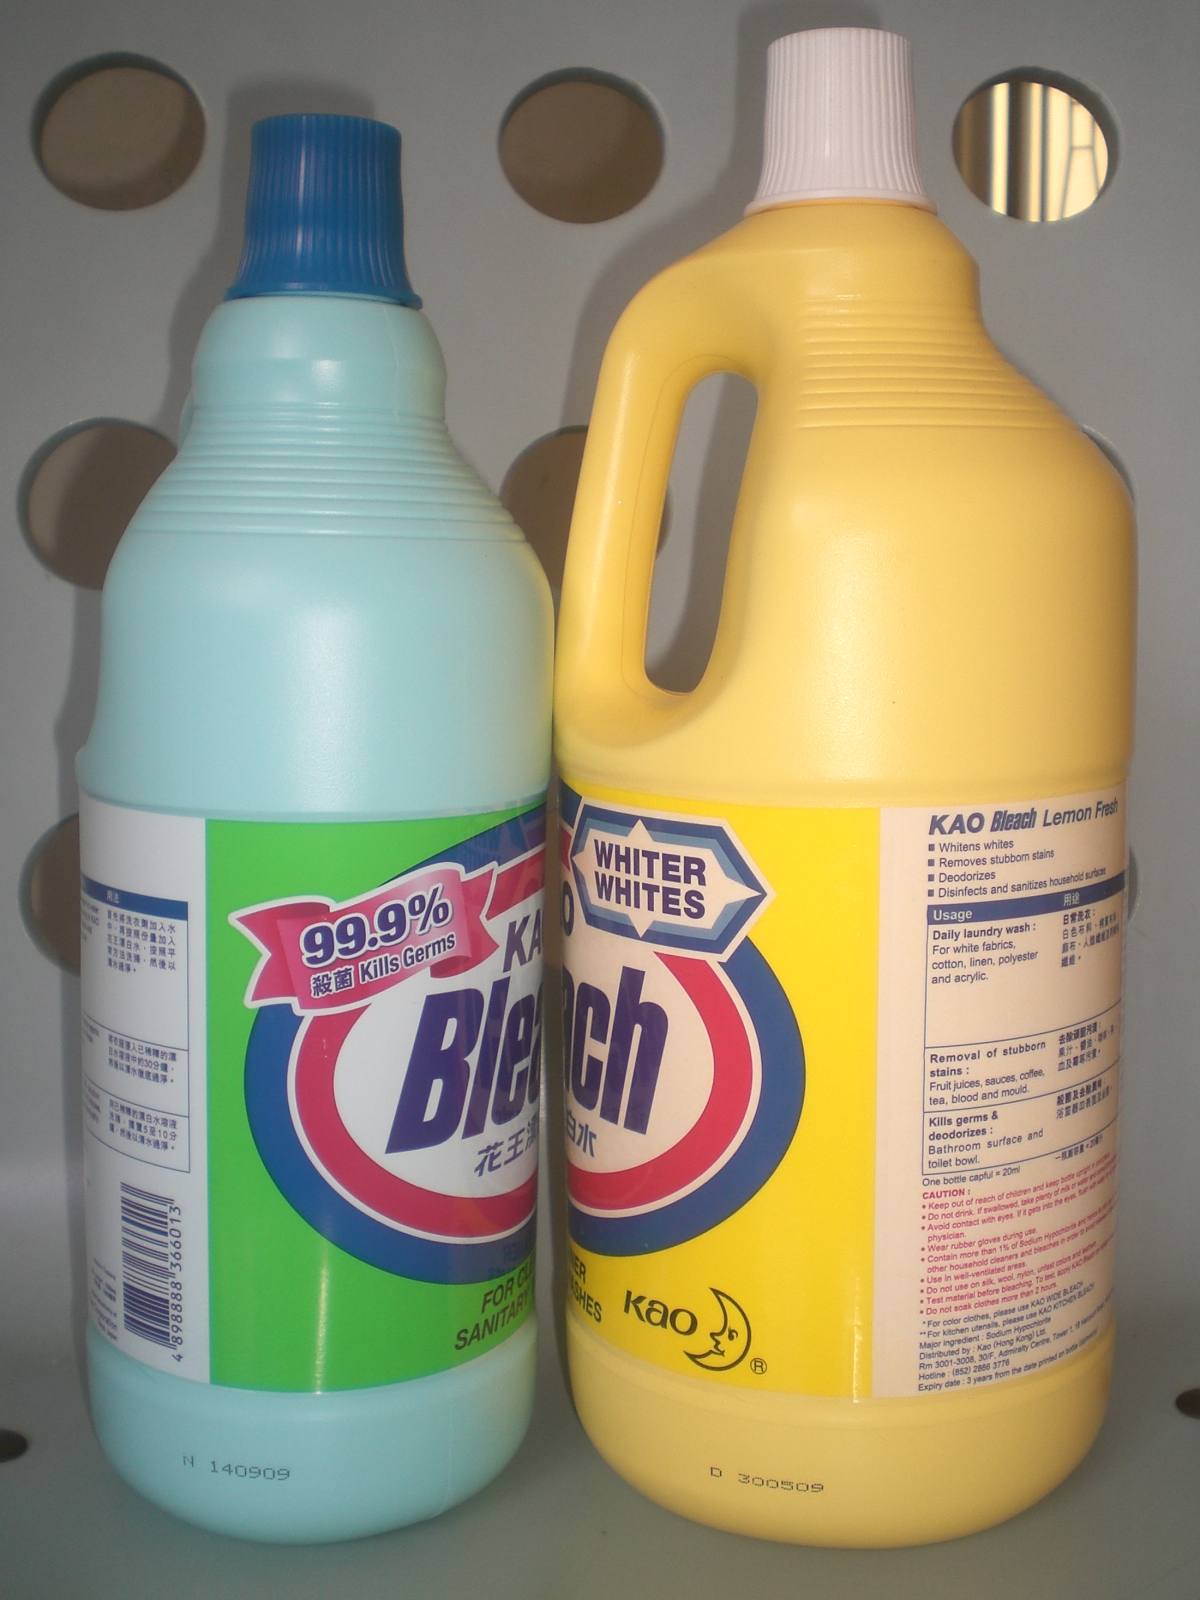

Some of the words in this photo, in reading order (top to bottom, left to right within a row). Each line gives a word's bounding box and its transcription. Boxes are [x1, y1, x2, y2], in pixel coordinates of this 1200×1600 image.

[929, 813, 985, 835] KAO
[990, 808, 1037, 832] Bleach
[1043, 807, 1091, 827] Lemon
[1095, 798, 1118, 816] Fresh
[939, 841, 980, 852] Whitens
[984, 840, 1014, 850] whites
[594, 839, 706, 886] WHITER
[939, 857, 987, 867] Removes
[990, 854, 1029, 865] stubborn
[1033, 850, 1054, 860] stains
[939, 872, 996, 883] Deodorizes
[939, 887, 987, 897] Disinfects
[991, 885, 1008, 894] and
[1011, 880, 1047, 892] sanitizes
[1050, 872, 1084, 886] household
[1086, 867, 1106, 880] surfaces
[595, 871, 706, 919] WHITES
[303, 888, 450, 965] 99.9%
[933, 910, 972, 922] Usage
[933, 929, 960, 941] Daily
[964, 925, 1002, 940] laundry
[1006, 923, 1030, 934] wash
[933, 945, 949, 954] For
[953, 943, 979, 954] white
[982, 940, 1016, 951] fabrics,
[360, 955, 399, 983] Kills
[403, 933, 455, 967] Germs
[932, 959, 966, 970] cotton,
[970, 957, 995, 967] linen,
[999, 950, 1038, 965] polyester
[311, 968, 353, 996] 殺菌
[932, 974, 950, 984] and
[954, 971, 989, 984] acrylic.
[930, 1050, 980, 1063] Removal
[987, 1048, 998, 1058] of
[1003, 1041, 1046, 1056] stubborn
[930, 1067, 962, 1077] stains
[930, 1081, 951, 1091] Fruit
[953, 1079, 982, 1091] juices,
[985, 1075, 1017, 1085] sauces,
[1020, 1068, 1044, 1080] coffee,
[929, 1096, 948, 1106] tea,
[952, 1093, 978, 1103] blood
[982, 1090, 998, 1100] and
[1002, 1085, 1029, 1097] mould.
[929, 1116, 952, 1126] Kills
[956, 1113, 988, 1126] germs
[929, 1127, 987, 1141] deodorizes
[929, 1142, 981, 1155] Bathroom
[987, 1135, 1022, 1148] surface
[1028, 1128, 1043, 1141] and
[929, 1157, 953, 1168] toilet
[955, 1155, 980, 1166] bowl.
[923, 1177, 940, 1186] One
[944, 1173, 966, 1184] bottle
[969, 1171, 993, 1182] capful
[1003, 1166, 1020, 1176] 20ml
[923, 1188, 965, 1199] CAUTION
[975, 1196, 995, 1204] reach
[1006, 1189, 1032, 1200] children
[1033, 1183, 1044, 1192] and
[1046, 1180, 1059, 1188] keep
[1036, 1192, 1052, 1203] plenty
[928, 1223, 950, 1231] Avoid
[952, 1219, 979, 1228] contact
[998, 1213, 1015, 1222] eyes.
[1028, 1206, 1041, 1216] gets
[169, 1206, 182, 1272] 366013
[928, 1232, 966, 1243] physician.
[951, 1241, 975, 1249] rubber
[978, 1236, 1000, 1247] gloves
[1003, 1232, 1023, 1241] during
[928, 1253, 957, 1263] Contain
[1020, 1237, 1042, 1247] Sodium
[950, 1258, 988, 1270] household
[990, 1253, 1018, 1264] cleaners
[1021, 1249, 1032, 1257] and
[571, 1256, 586, 1284] ER
[954, 1266, 1005, 1280] well-ventilated
[482, 1277, 514, 1313] FOR
[946, 1292, 975, 1302] material
[978, 1288, 999, 1297] before
[954, 1303, 972, 1312] soak
[974, 1299, 999, 1308] clothes
[1001, 1295, 1018, 1303] more
[1020, 1290, 1033, 1298] than
[171, 1281, 183, 1345] 898888
[455, 1286, 529, 1350] SANITARY
[623, 1290, 698, 1336] kao
[943, 1318, 961, 1326] color
[994, 1307, 1015, 1318] please
[1018, 1304, 1029, 1312] use
[1031, 1298, 1045, 1308] KAO
[1046, 1291, 1061, 1302] WIDE
[943, 1327, 969, 1336] kitchen
[1003, 1316, 1024, 1327] please
[1026, 1311, 1037, 1319] use
[1039, 1305, 1052, 1315] KAO
[919, 1341, 941, 1350] Major
[943, 1335, 979, 1347] ingredient
[986, 1329, 1012, 1339] Sodium
[1014, 1317, 1051, 1333] Hypochlorite
[172, 1354, 183, 1362] 4
[919, 1349, 959, 1360] Distributed
[919, 1372, 946, 1380] Hotline
[953, 1366, 971, 1376] (852)
[993, 1359, 1010, 1369] 3776
[918, 1383, 943, 1391] Expiry
[945, 1379, 960, 1387] date
[973, 1374, 992, 1384] years
[995, 1370, 1010, 1379] from
[183, 1456, 194, 1467] N
[211, 1461, 289, 1480] 140909
[711, 1467, 722, 1477] D
[738, 1473, 823, 1492] 300509
